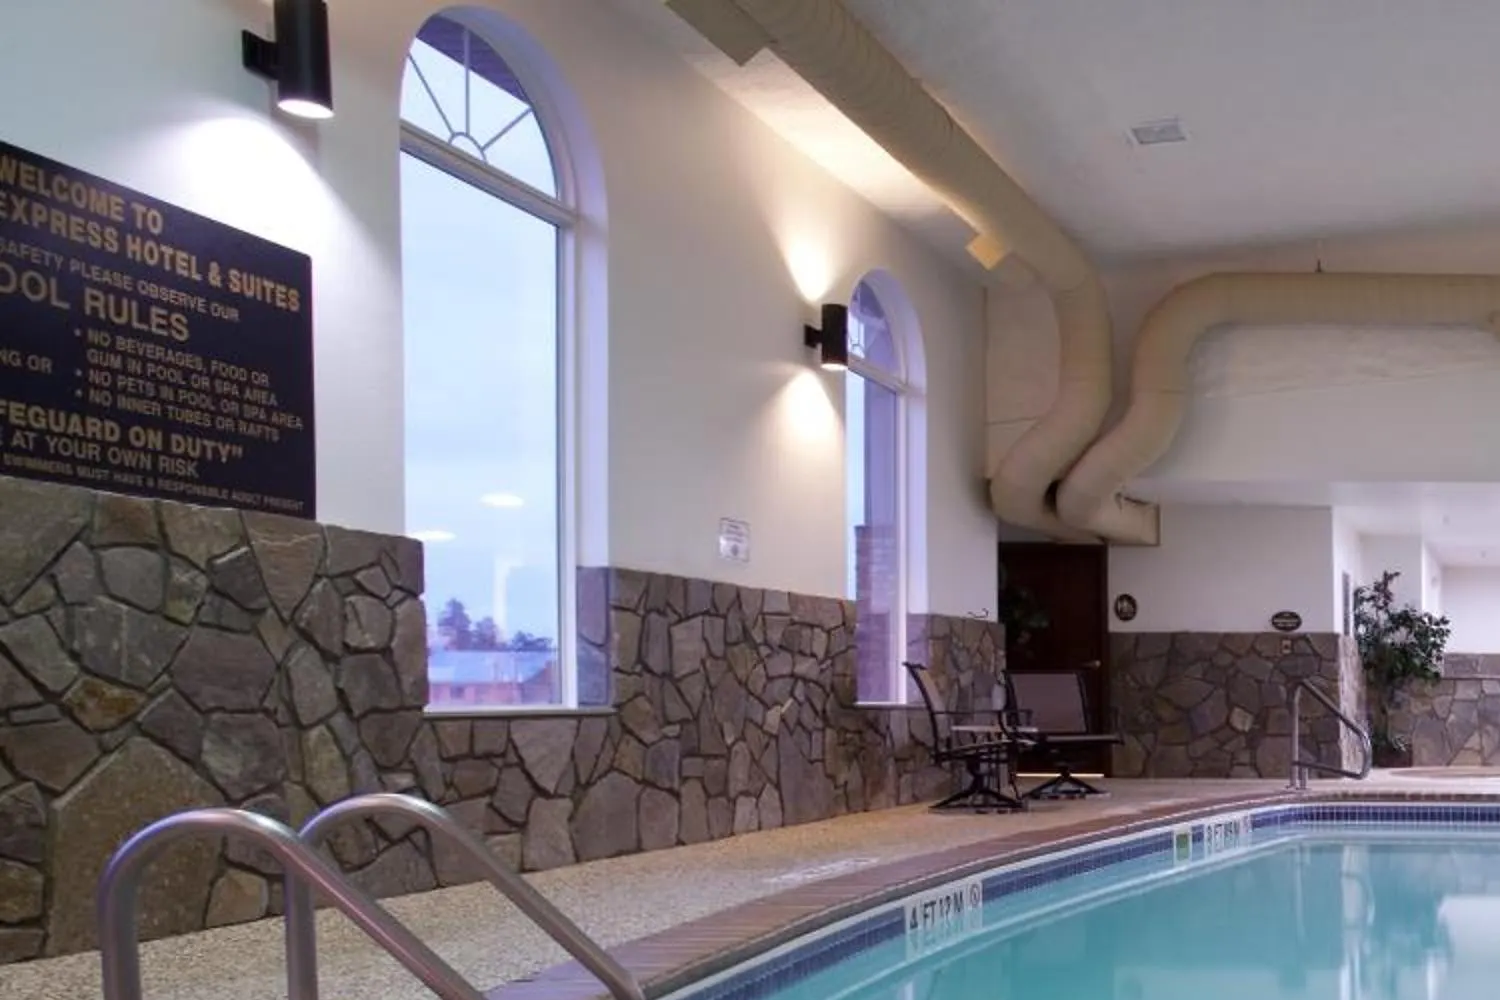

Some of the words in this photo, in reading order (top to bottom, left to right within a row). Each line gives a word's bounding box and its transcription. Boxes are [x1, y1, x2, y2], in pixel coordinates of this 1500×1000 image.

[0, 154, 125, 222] WELCOME
[131, 202, 163, 235] TO
[70, 258, 133, 291] PLEASE
[137, 279, 207, 314] OBSERVE
[210, 301, 240, 322] OUR
[126, 233, 202, 281] HOTEL
[208, 261, 222, 288] &
[228, 268, 300, 312] SUITES
[84, 287, 190, 342] RULES
[27, 357, 52, 374] OR
[86, 348, 122, 370] GUM
[127, 358, 143, 376] IN
[147, 363, 187, 385] POOL
[190, 374, 211, 390] OR
[244, 389, 278, 407] AREA
[87, 328, 111, 347] NO
[211, 359, 248, 382] FOOD
[251, 371, 270, 388] OR
[88, 369, 112, 387] NO
[117, 375, 156, 398] PETS
[220, 398, 240, 417] OR
[271, 412, 304, 431] AREA
[88, 388, 112, 407] NO
[165, 405, 212, 428] TUBES
[215, 415, 235, 433] OR
[238, 419, 280, 443] RAFTS
[11, 430, 36, 451] AT
[45, 436, 100, 463] YOUR
[107, 446, 153, 471] OWN
[158, 455, 199, 479] RISK
[128, 425, 163, 452] ON
